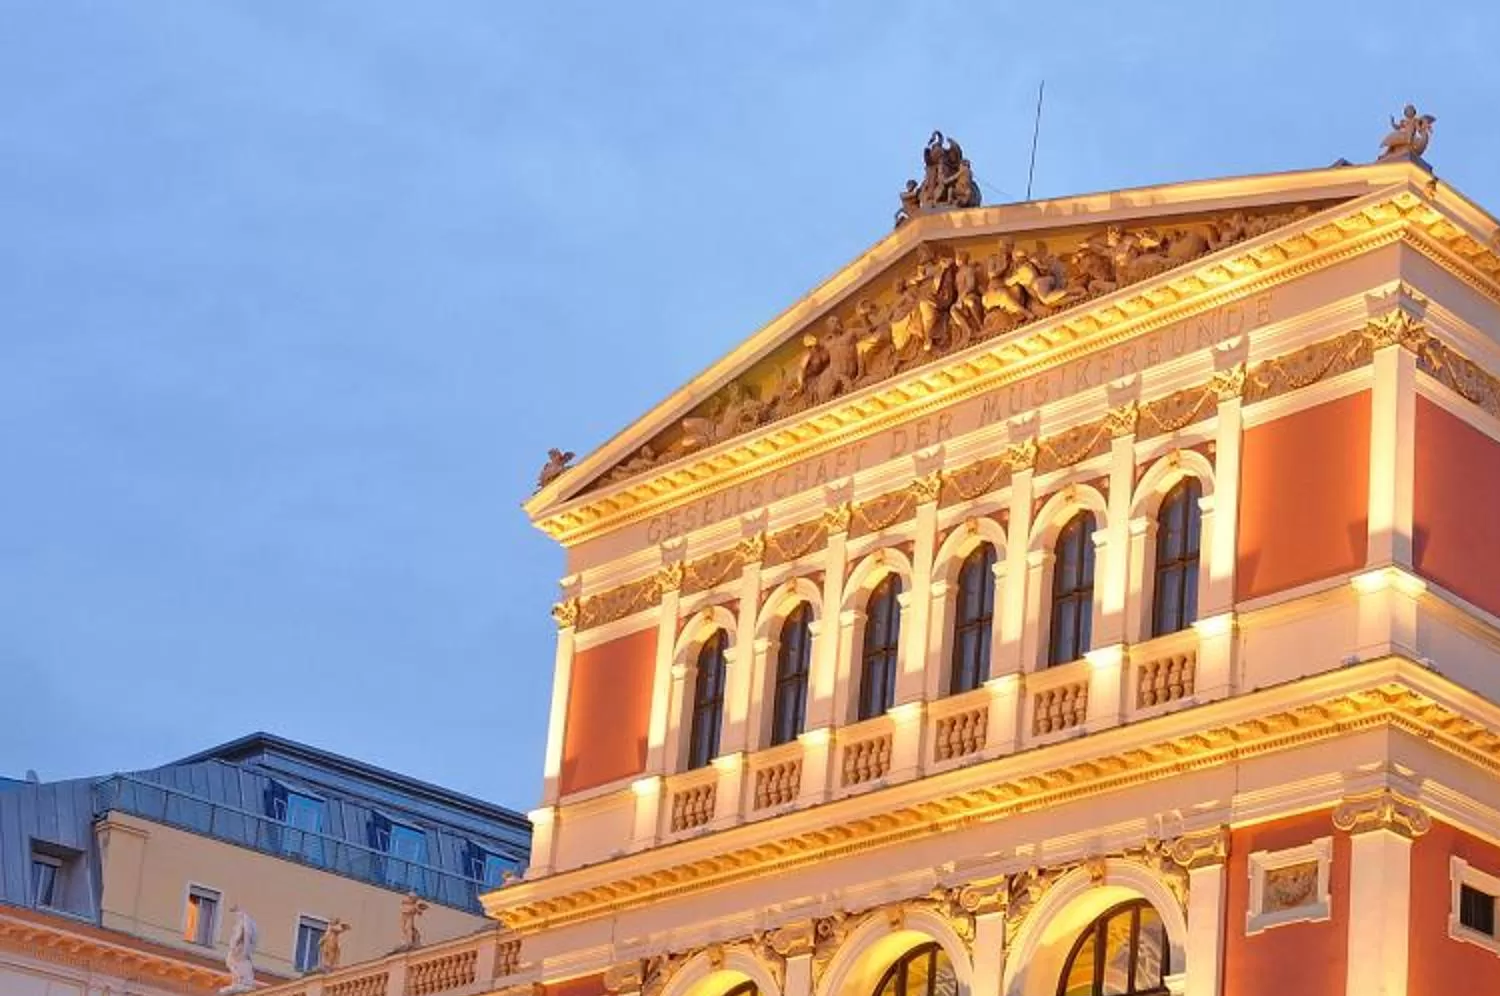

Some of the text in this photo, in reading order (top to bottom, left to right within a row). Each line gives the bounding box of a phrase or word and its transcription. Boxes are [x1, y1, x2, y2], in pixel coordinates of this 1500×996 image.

[647, 291, 1274, 544] GESELLSCHAFT DER MUSIKFREUNDE
